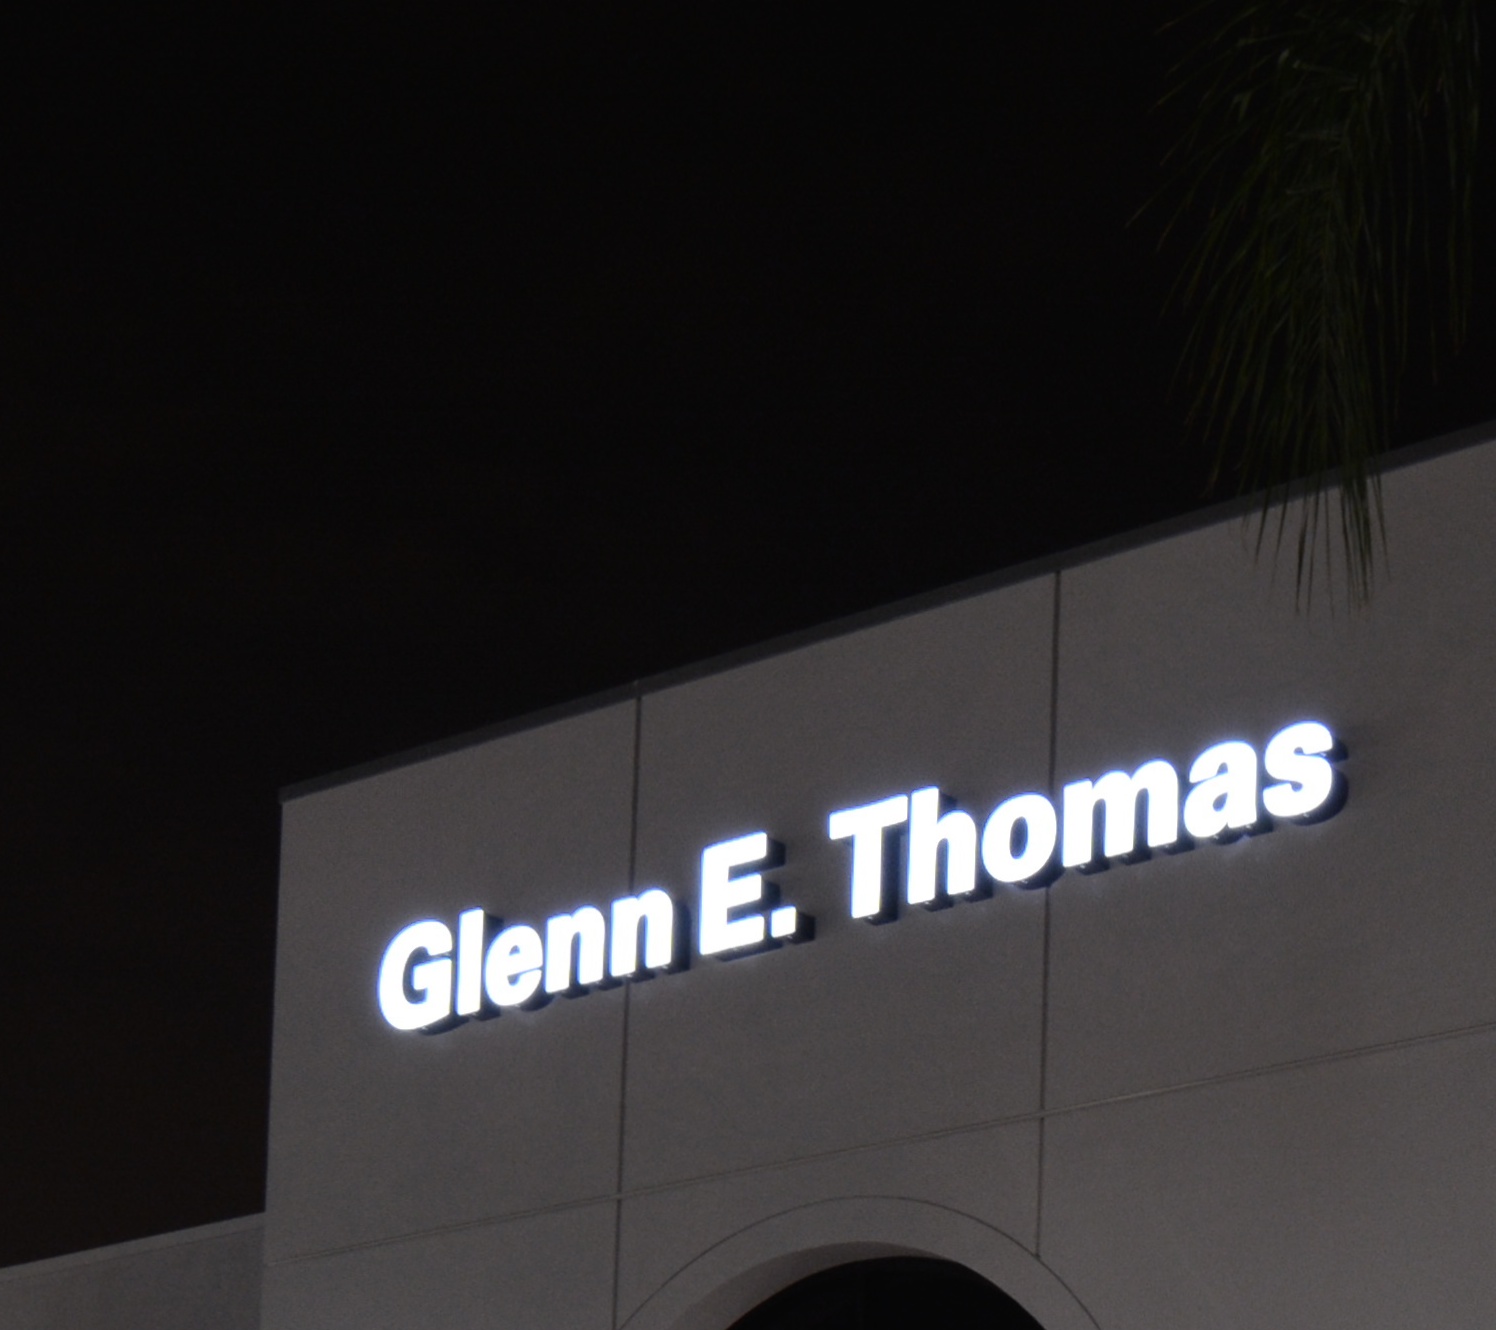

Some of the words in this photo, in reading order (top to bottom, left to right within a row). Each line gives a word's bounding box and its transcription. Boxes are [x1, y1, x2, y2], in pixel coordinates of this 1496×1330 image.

[377, 886, 676, 1033] Glenn
[698, 832, 798, 956] E.
[829, 719, 1336, 921] Thomas
